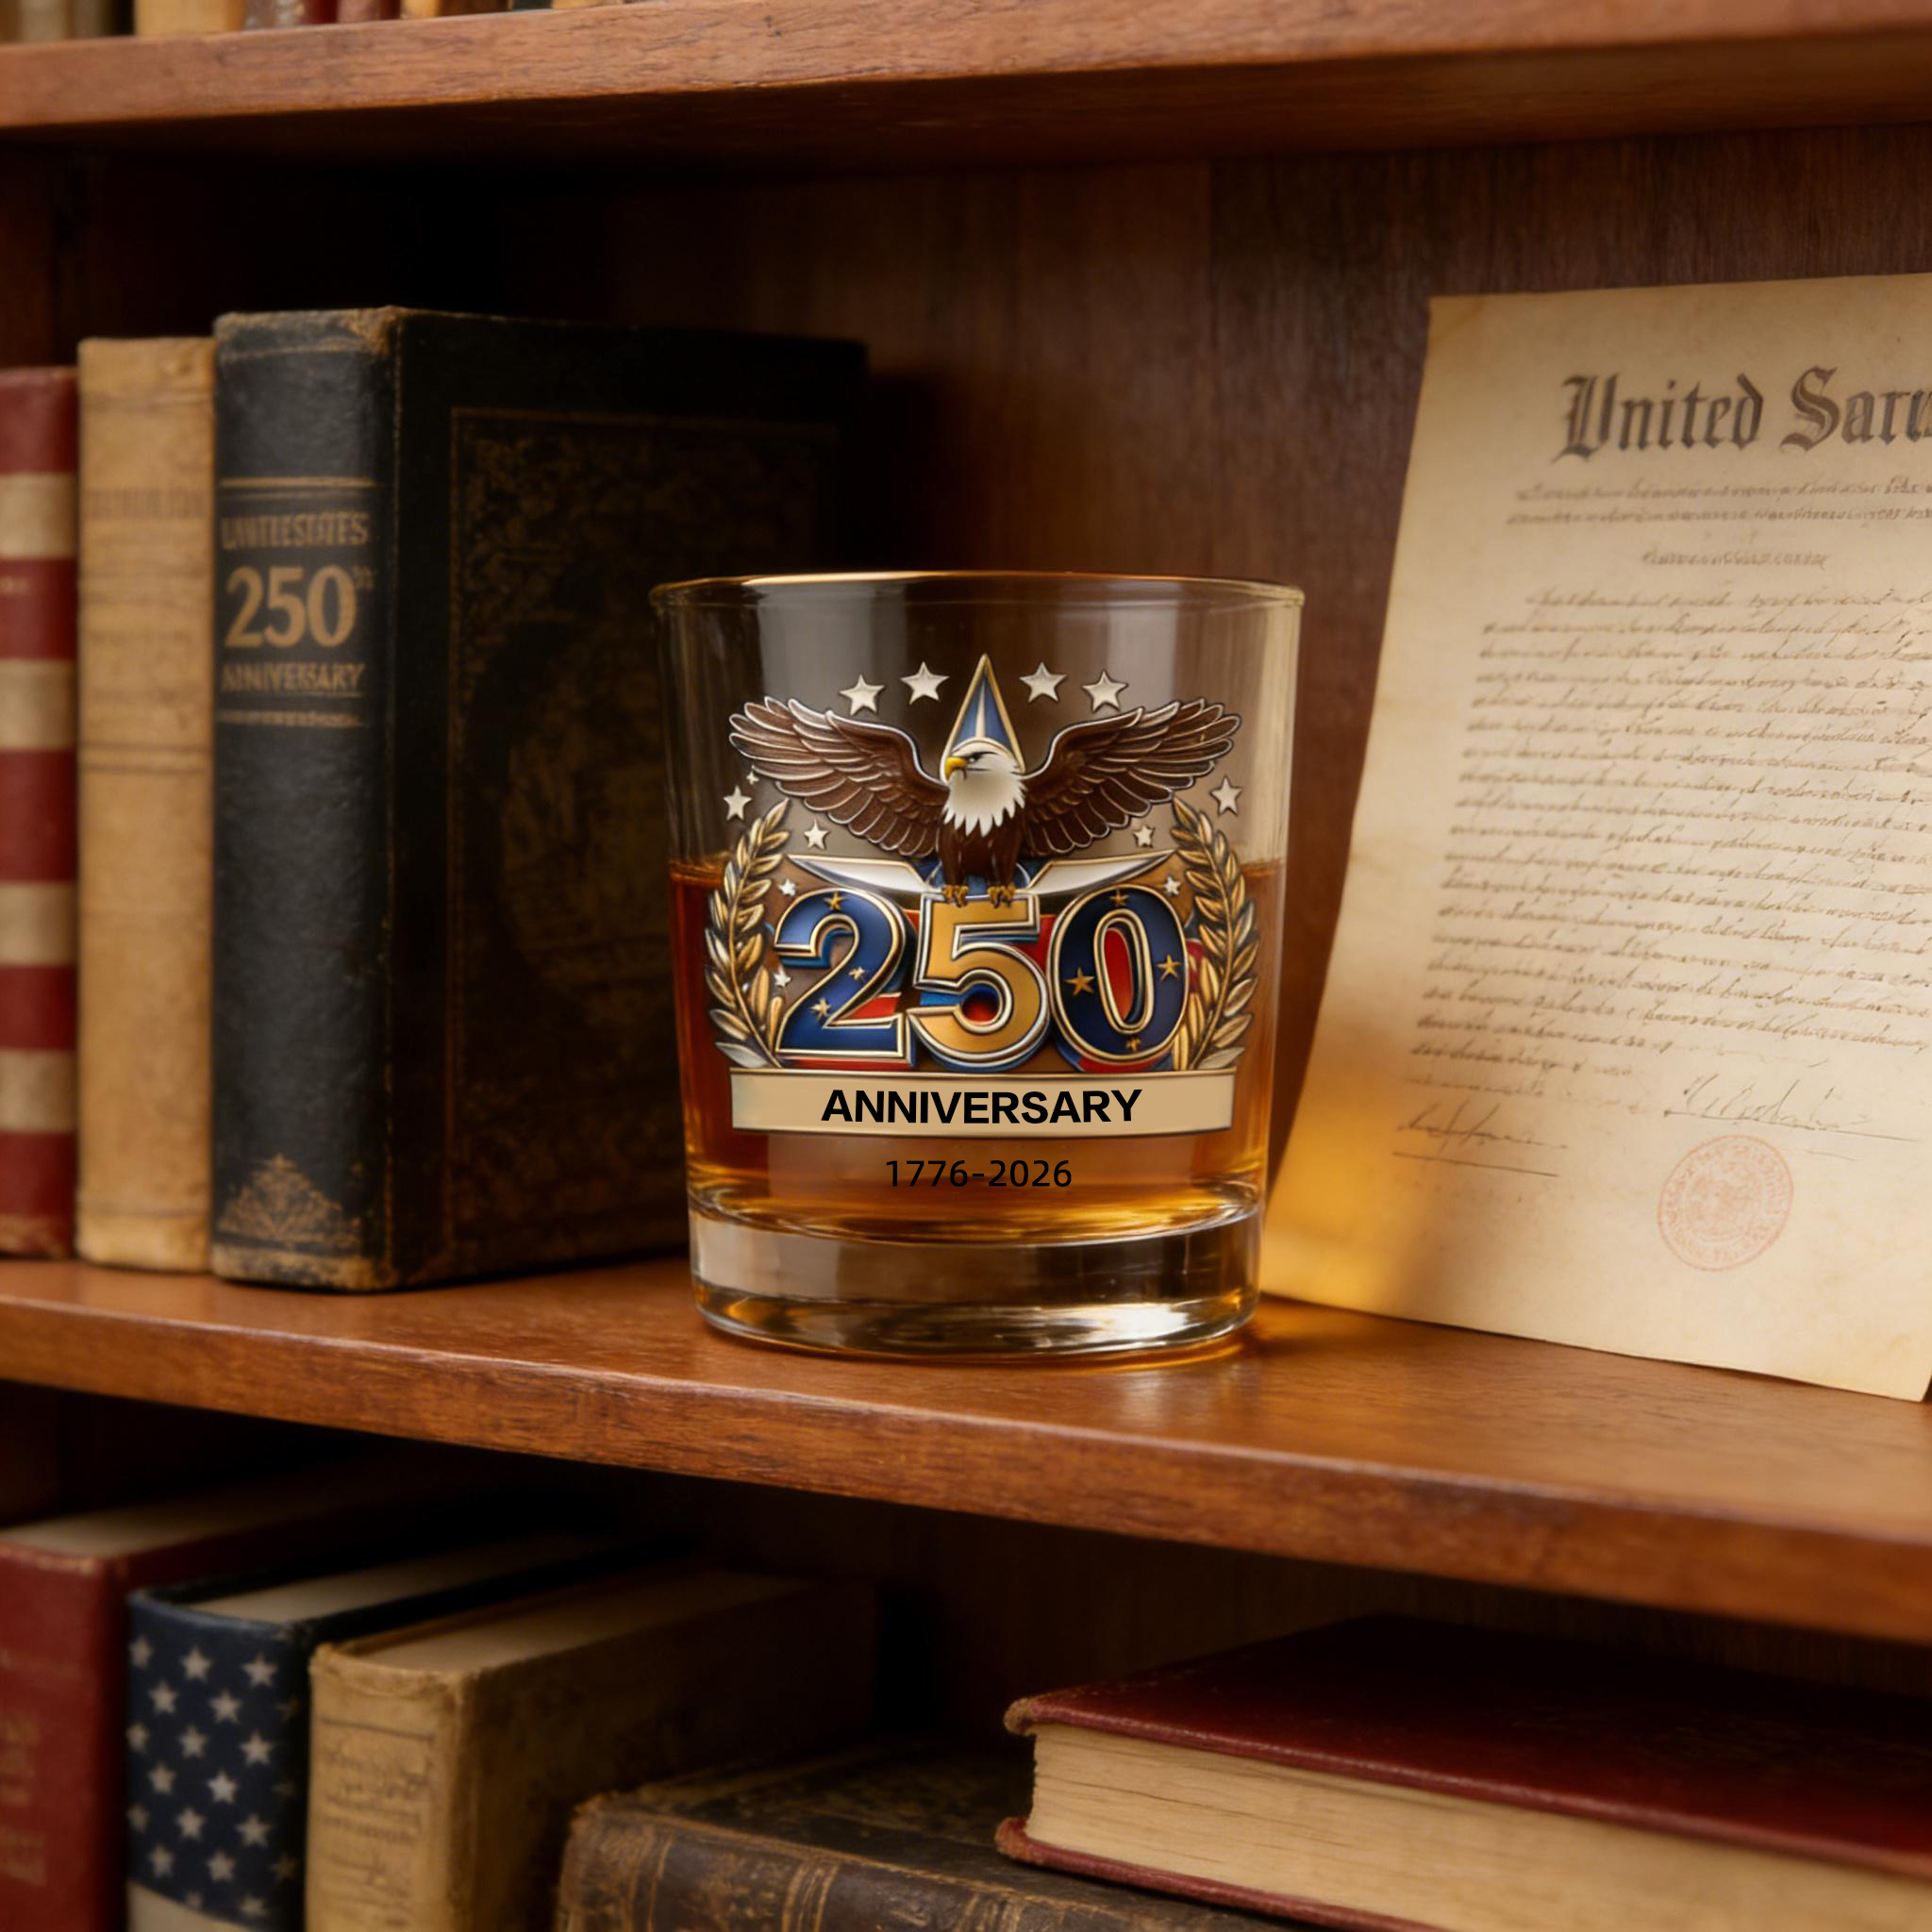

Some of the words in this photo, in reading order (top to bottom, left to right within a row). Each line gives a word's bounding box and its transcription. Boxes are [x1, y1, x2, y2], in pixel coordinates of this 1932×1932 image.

[1552, 373, 1764, 464] United
[774, 884, 1189, 1072] 250
[821, 1089, 1142, 1124] ANNIVERSARY
[886, 1159, 1073, 1188] 1776-2026
